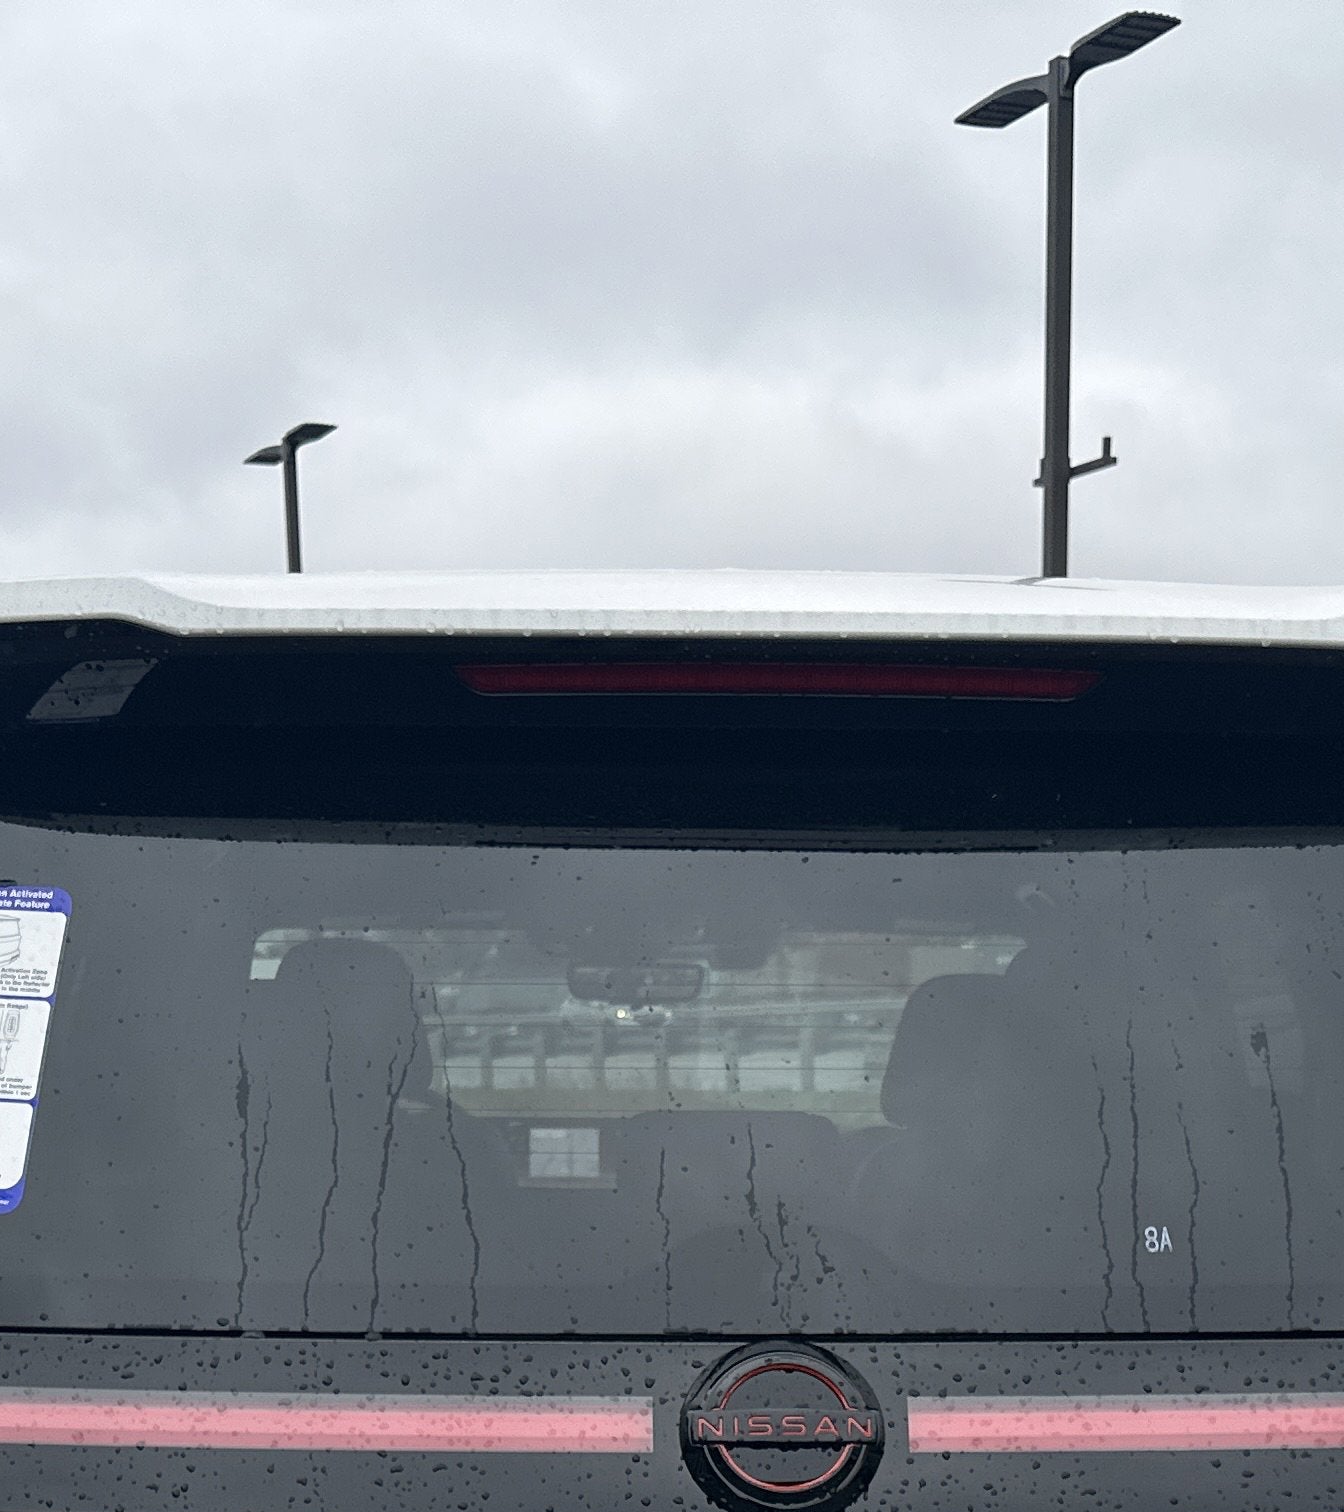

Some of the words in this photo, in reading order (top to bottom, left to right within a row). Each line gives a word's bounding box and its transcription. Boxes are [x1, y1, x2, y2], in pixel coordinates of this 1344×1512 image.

[9, 889, 54, 899] Activated
[14, 899, 51, 909] Feature
[1144, 1226, 1173, 1253] 8A
[697, 1414, 873, 1438] NISSAN
